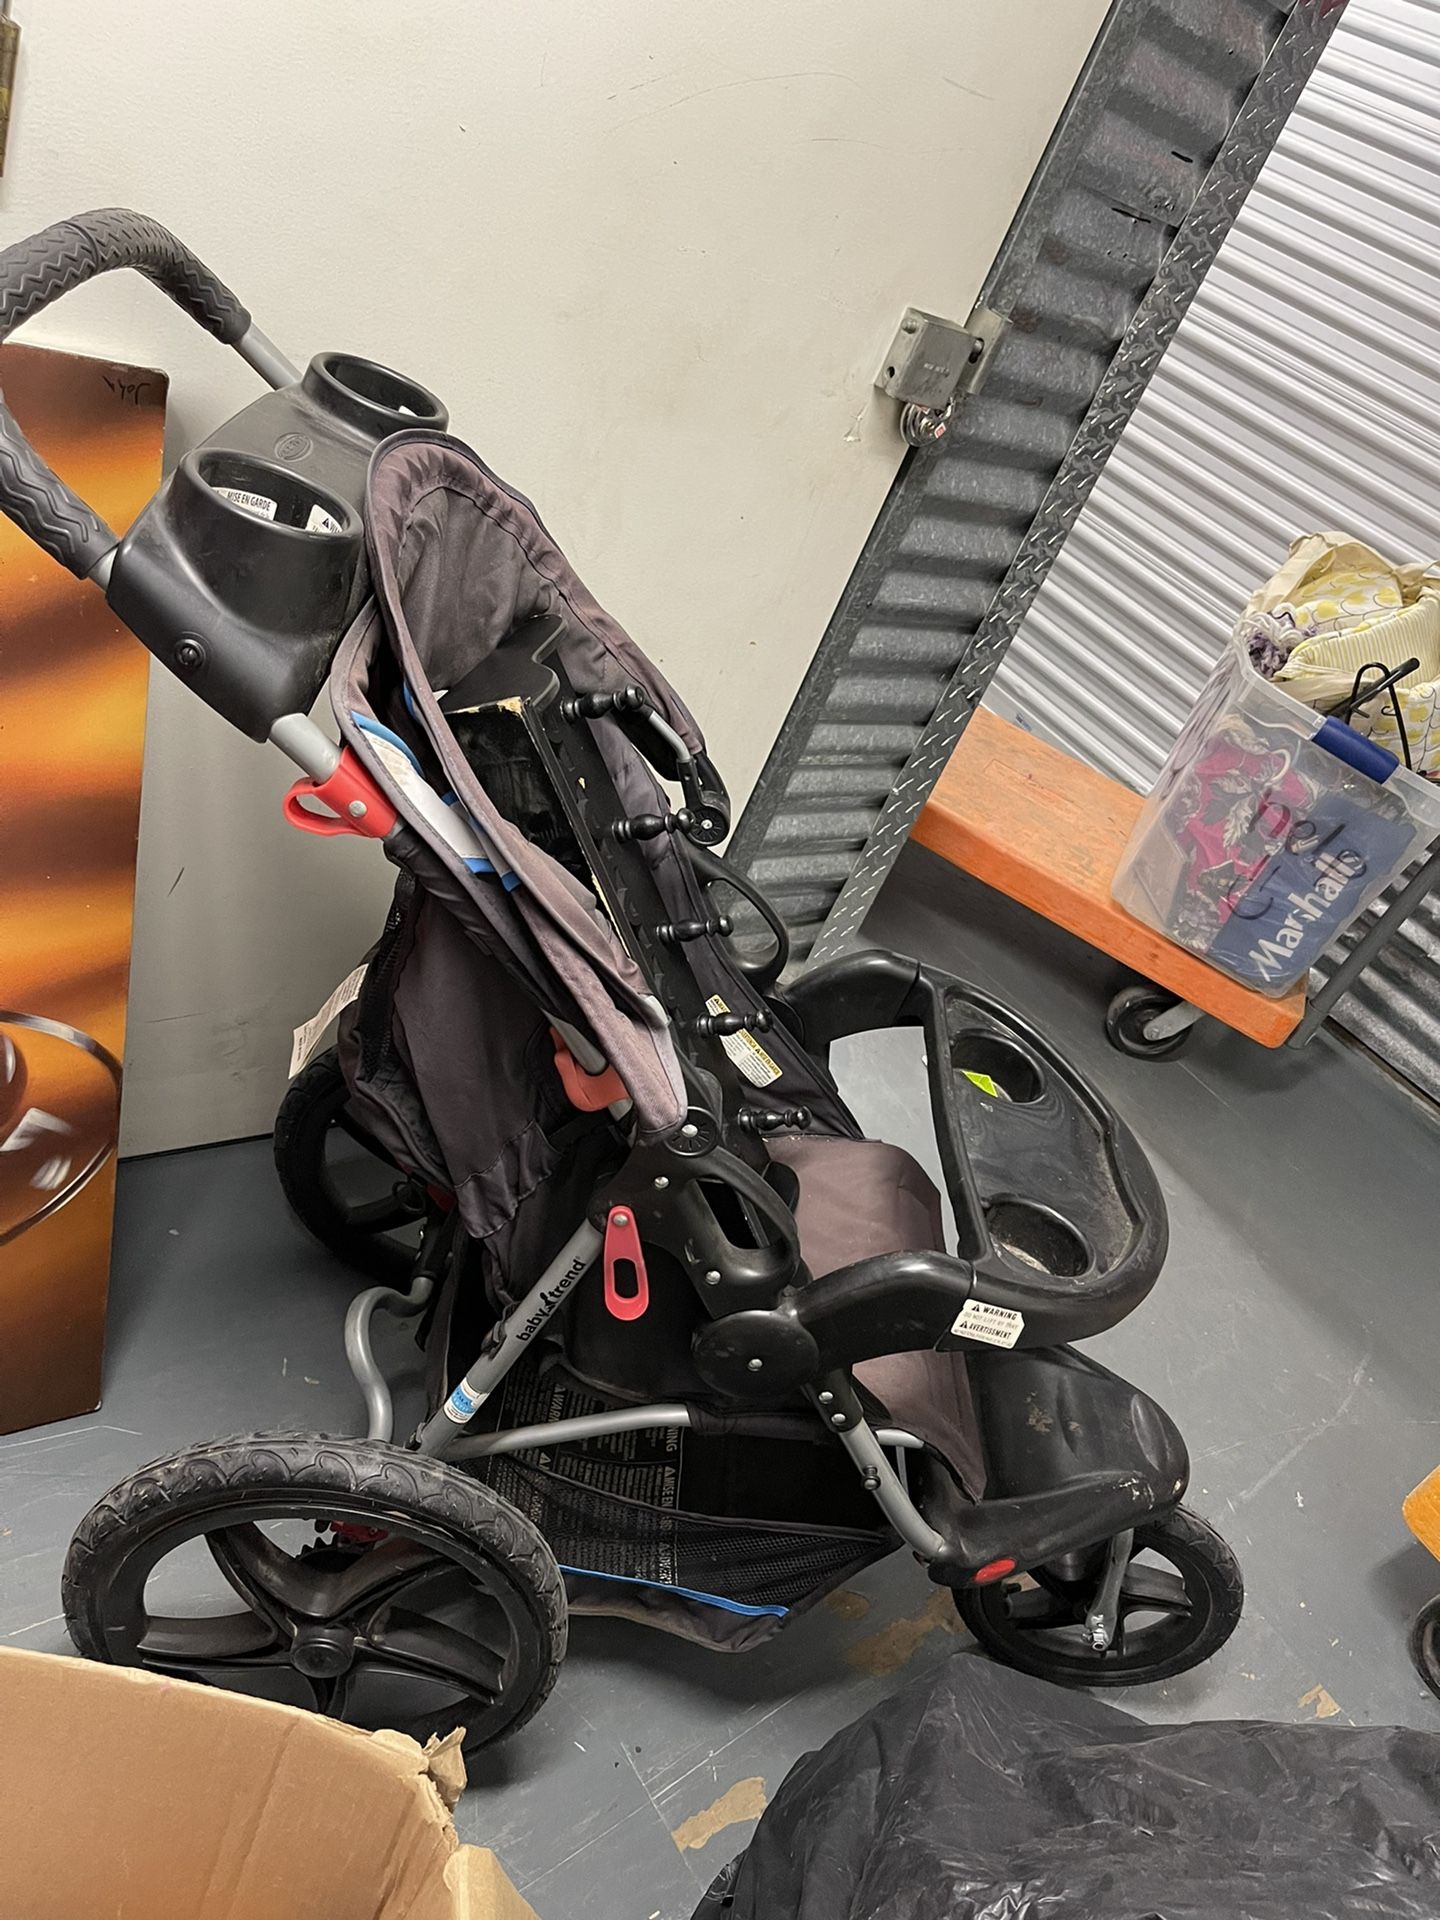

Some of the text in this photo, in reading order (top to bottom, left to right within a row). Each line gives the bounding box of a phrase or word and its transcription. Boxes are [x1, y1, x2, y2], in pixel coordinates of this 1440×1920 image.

[227, 491, 271, 511] MISE EN GARDE
[1248, 850, 1362, 982] Marshalls
[516, 1308, 549, 1341] baby
[548, 1258, 586, 1299] trend
[983, 1306, 1018, 1321] WARNING
